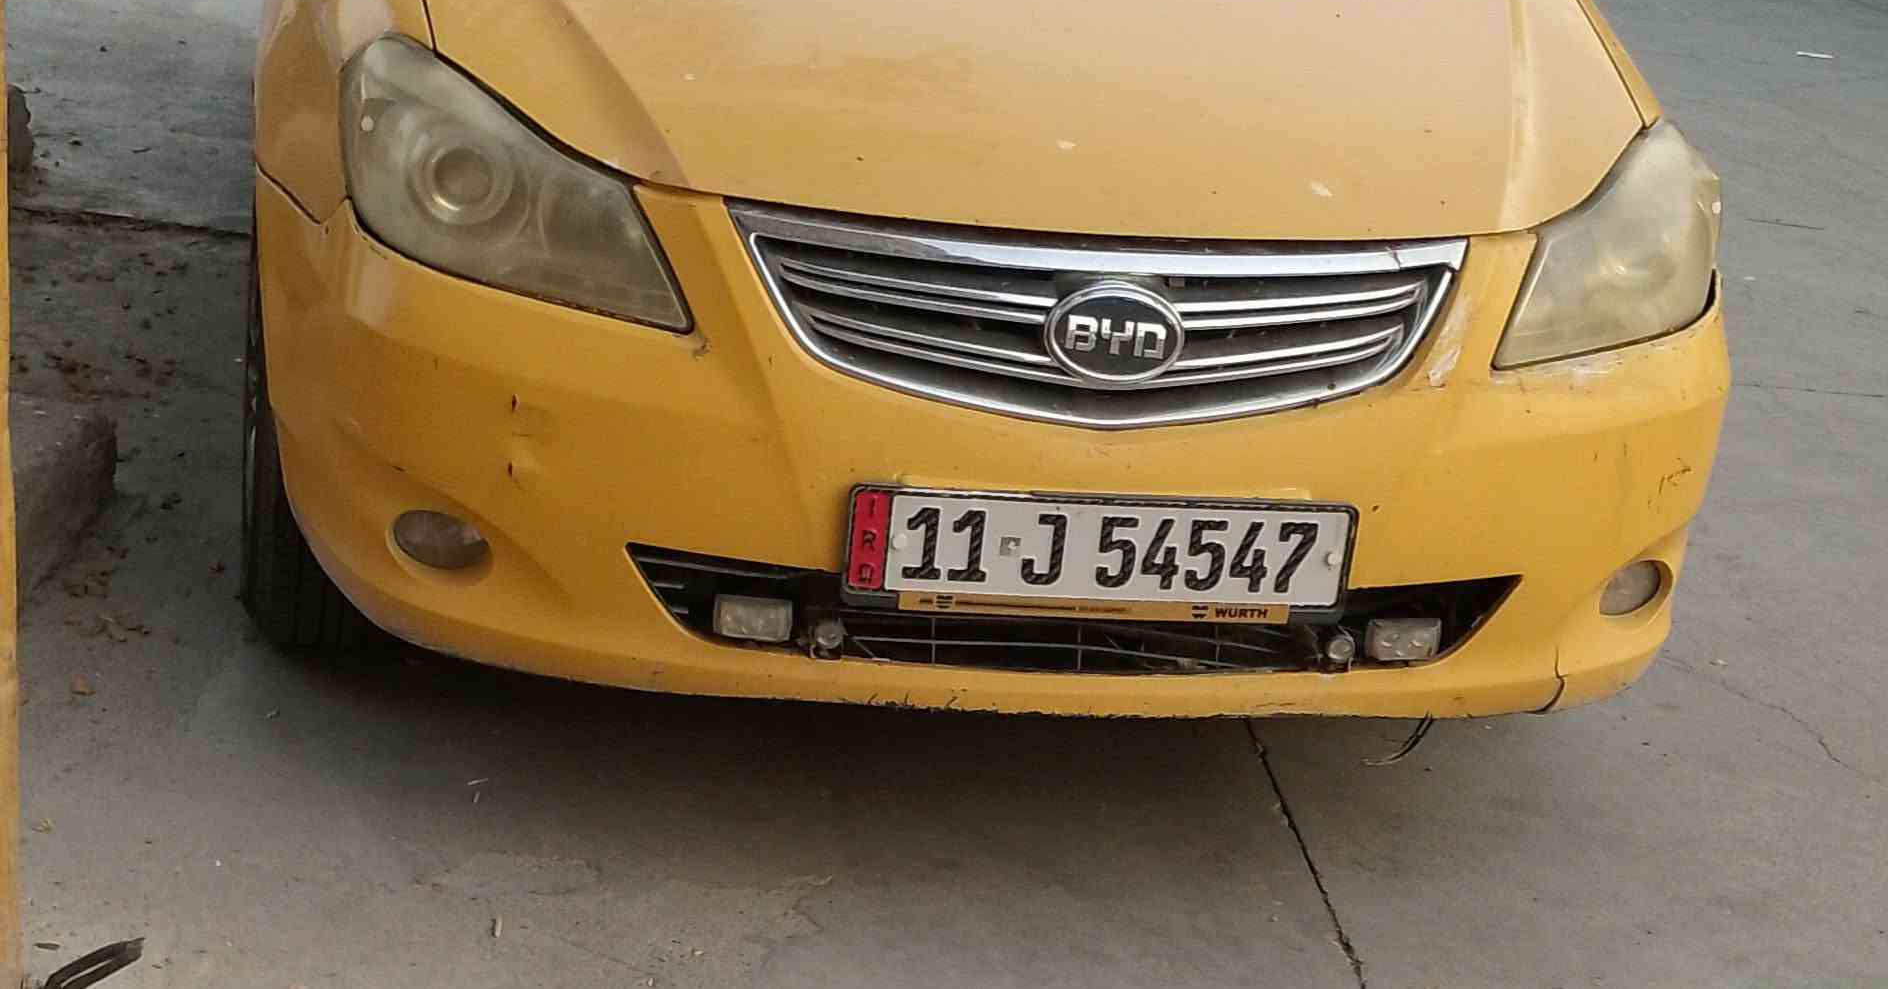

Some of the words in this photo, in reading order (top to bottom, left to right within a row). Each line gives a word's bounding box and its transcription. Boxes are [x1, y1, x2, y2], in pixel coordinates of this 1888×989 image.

[1064, 314, 1167, 360] BYD
[901, 506, 988, 583] 11
[1019, 513, 1068, 586] J
[1094, 515, 1320, 594] 54547
